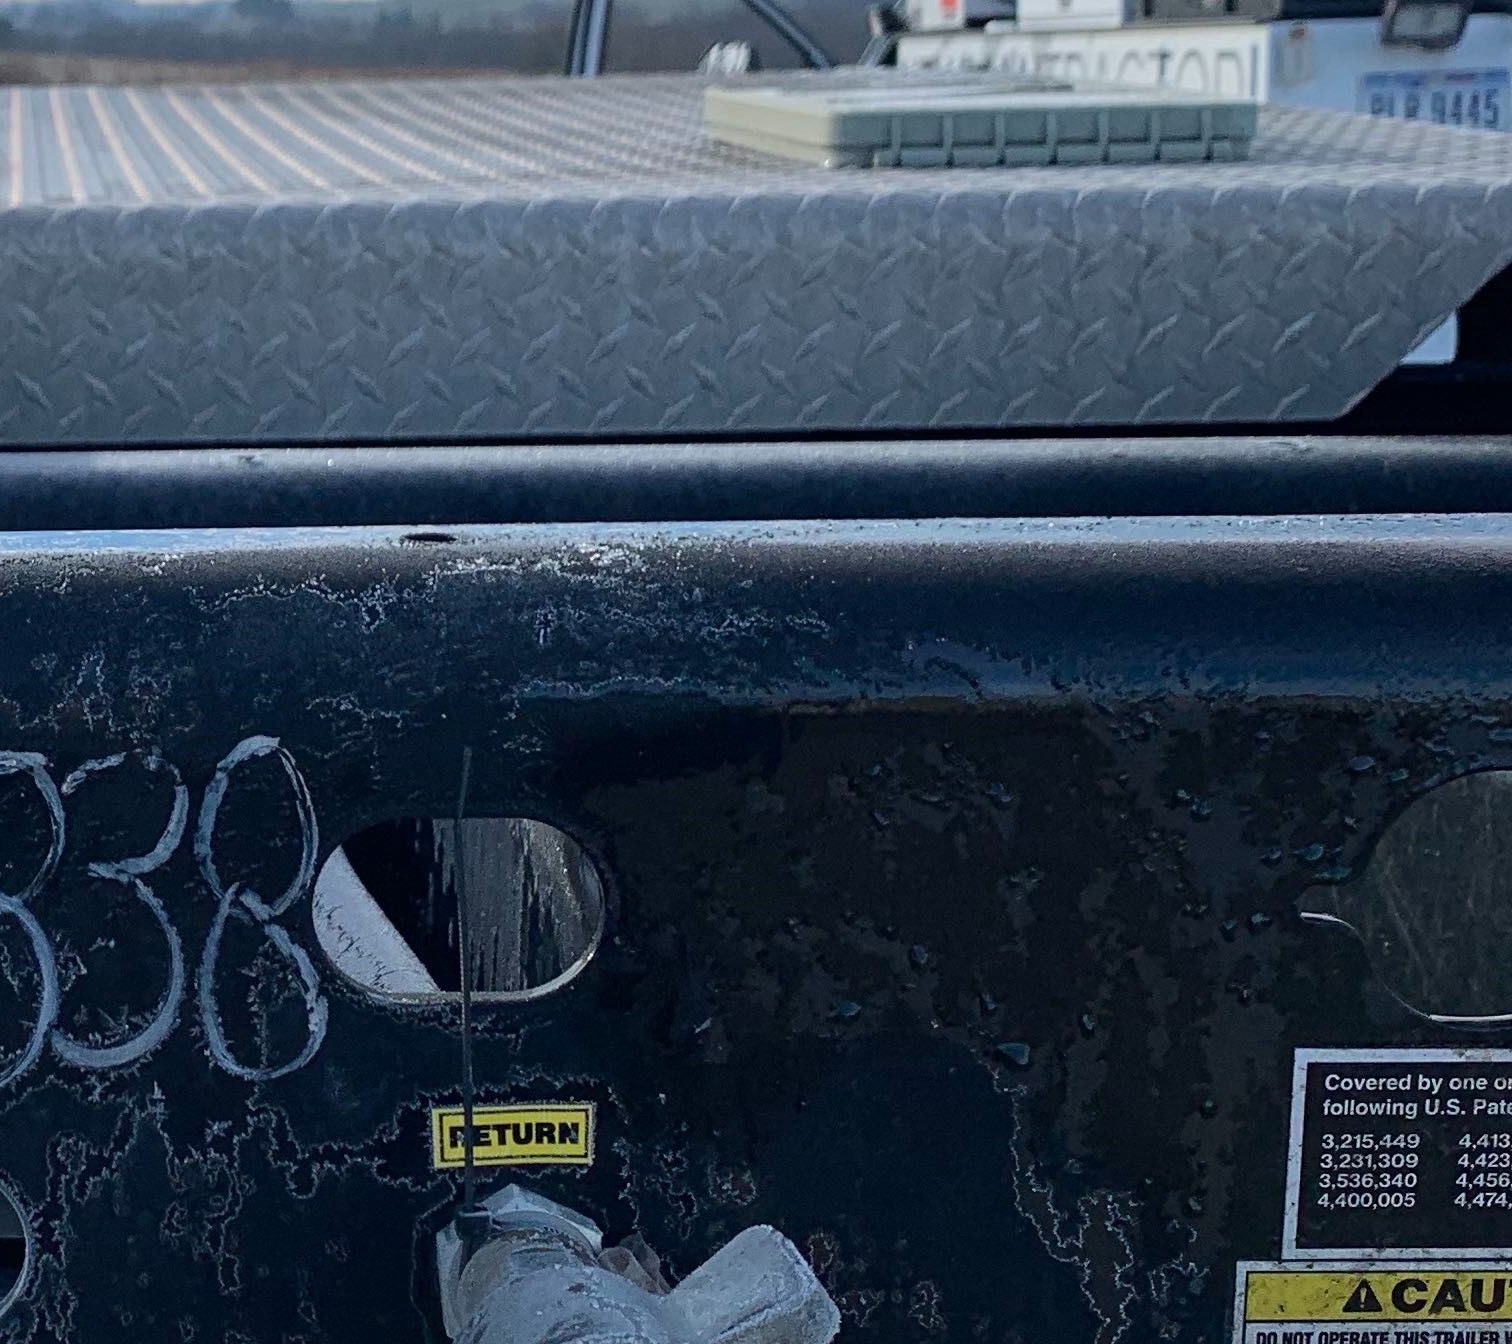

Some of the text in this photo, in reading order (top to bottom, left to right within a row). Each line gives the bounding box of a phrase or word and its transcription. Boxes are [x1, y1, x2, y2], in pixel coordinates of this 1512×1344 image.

[1325, 1074, 1411, 1090] Covered
[1418, 1074, 1443, 1094] by
[1449, 1078, 1488, 1090] one
[1323, 1099, 1417, 1119] following
[1425, 1099, 1465, 1115] U.S.
[449, 1122, 579, 1148] RETURN
[1322, 1134, 1420, 1151] 3,215,449
[1320, 1153, 1418, 1170] 3,231,309
[1319, 1173, 1417, 1190] 3,536,340
[1318, 1193, 1415, 1210] 4,400,005
